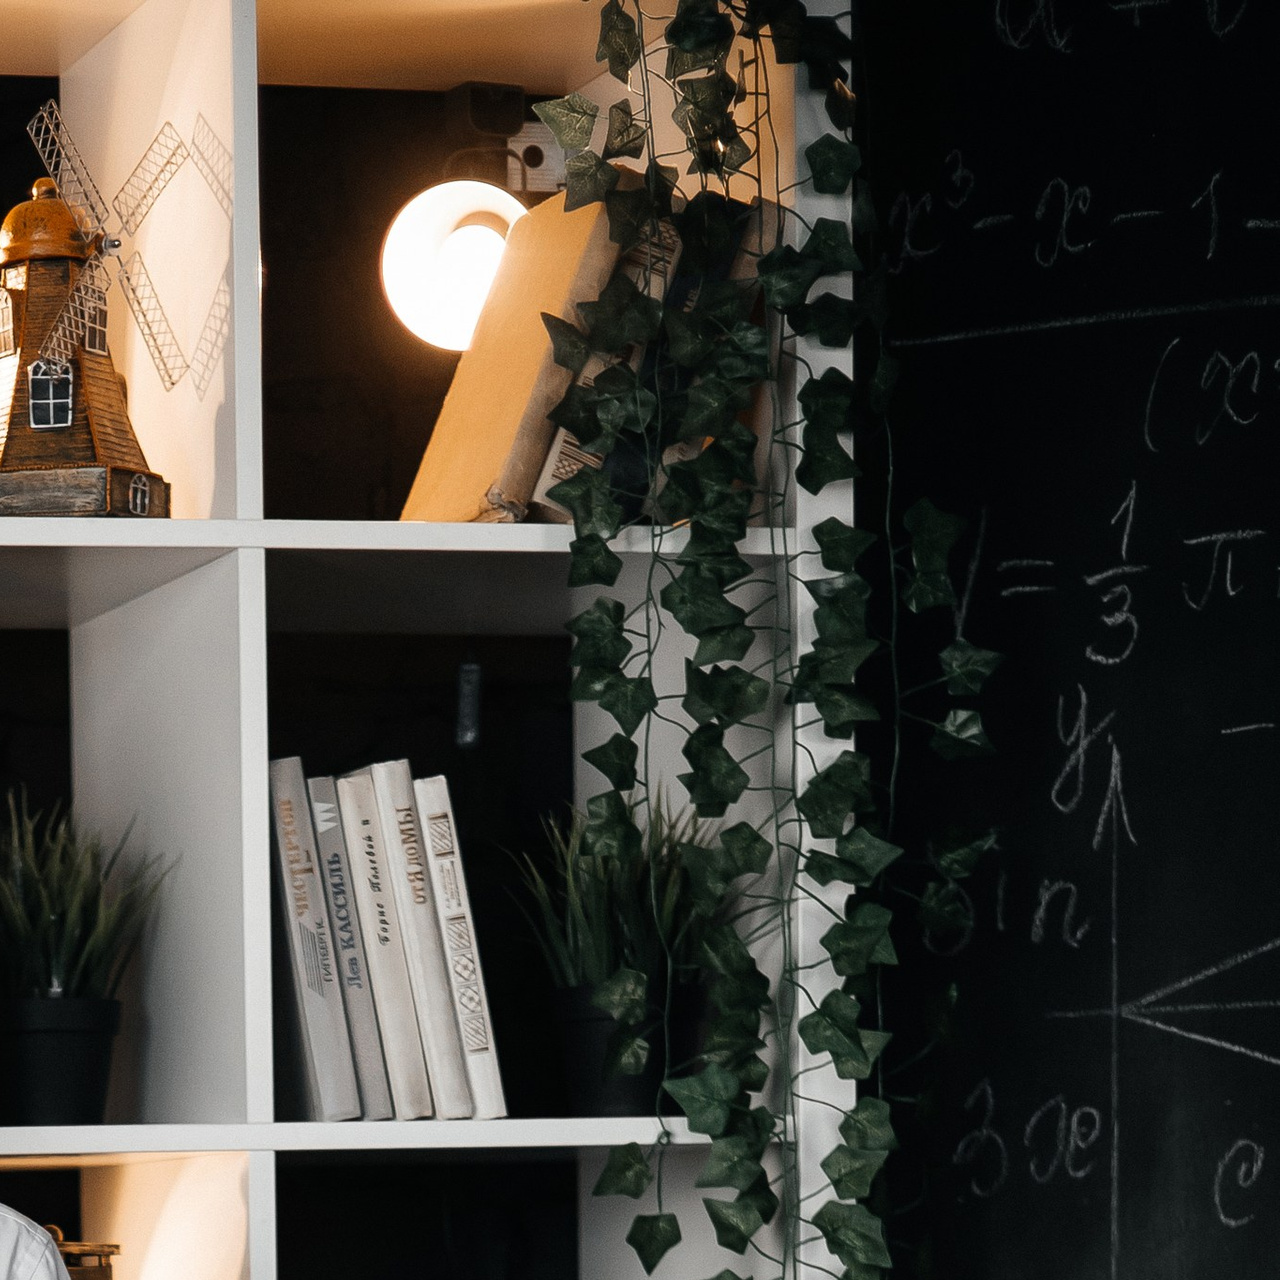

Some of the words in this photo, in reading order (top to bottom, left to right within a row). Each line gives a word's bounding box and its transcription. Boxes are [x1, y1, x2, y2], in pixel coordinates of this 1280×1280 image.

[360, 835, 382, 893] Полевой
[325, 852, 355, 951] КАССИЛЬ
[373, 902, 391, 946] Борис
[344, 956, 362, 991] Лев
